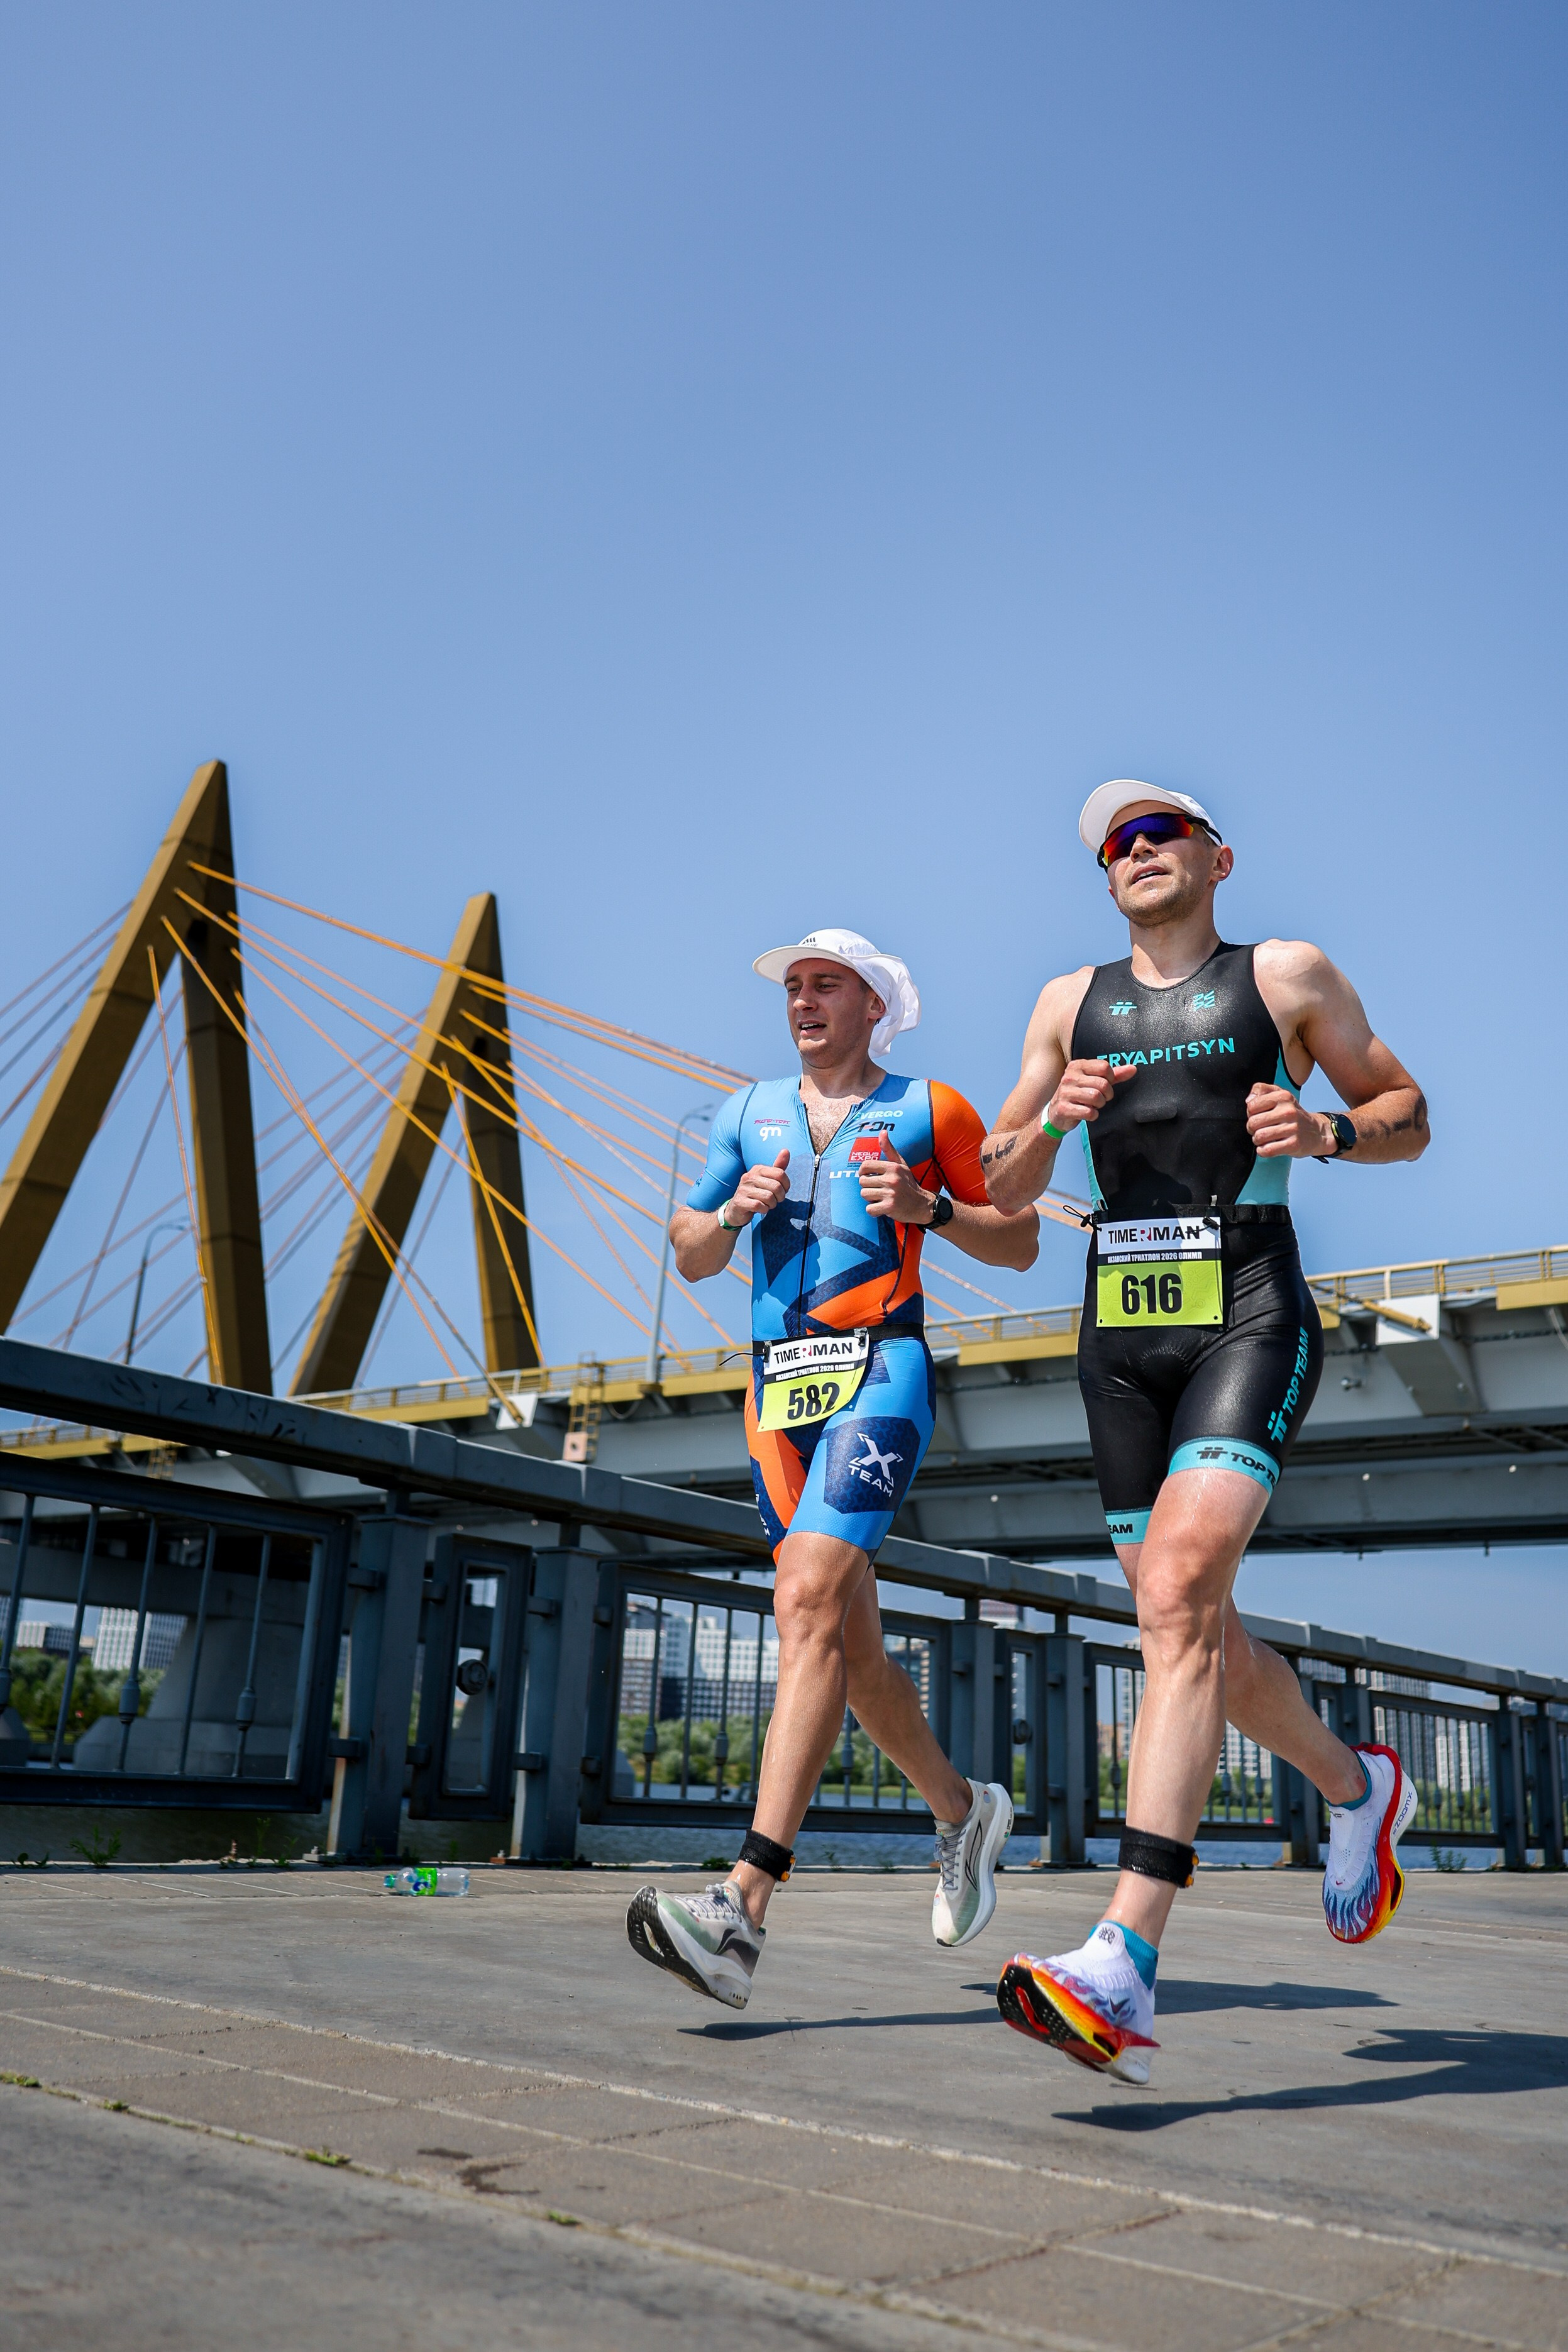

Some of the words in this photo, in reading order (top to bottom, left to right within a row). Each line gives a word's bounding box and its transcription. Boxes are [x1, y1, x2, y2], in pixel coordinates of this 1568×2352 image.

[1107, 1254, 1131, 1264] КАЗАНСКИЙ
[1131, 1253, 1161, 1262] ТРИАТЛОН
[1161, 1252, 1178, 1261] 2026
[1178, 1251, 1203, 1260] ОЛИМП
[1122, 1273, 1182, 1316] 616
[820, 1364, 834, 1372] 2026
[1282, 1376, 1300, 1415] TOP
[1294, 1326, 1308, 1379] TEAM
[787, 1382, 840, 1420] 582
[1231, 1452, 1266, 1471] TOP
[848, 1464, 893, 1498] TEAM
